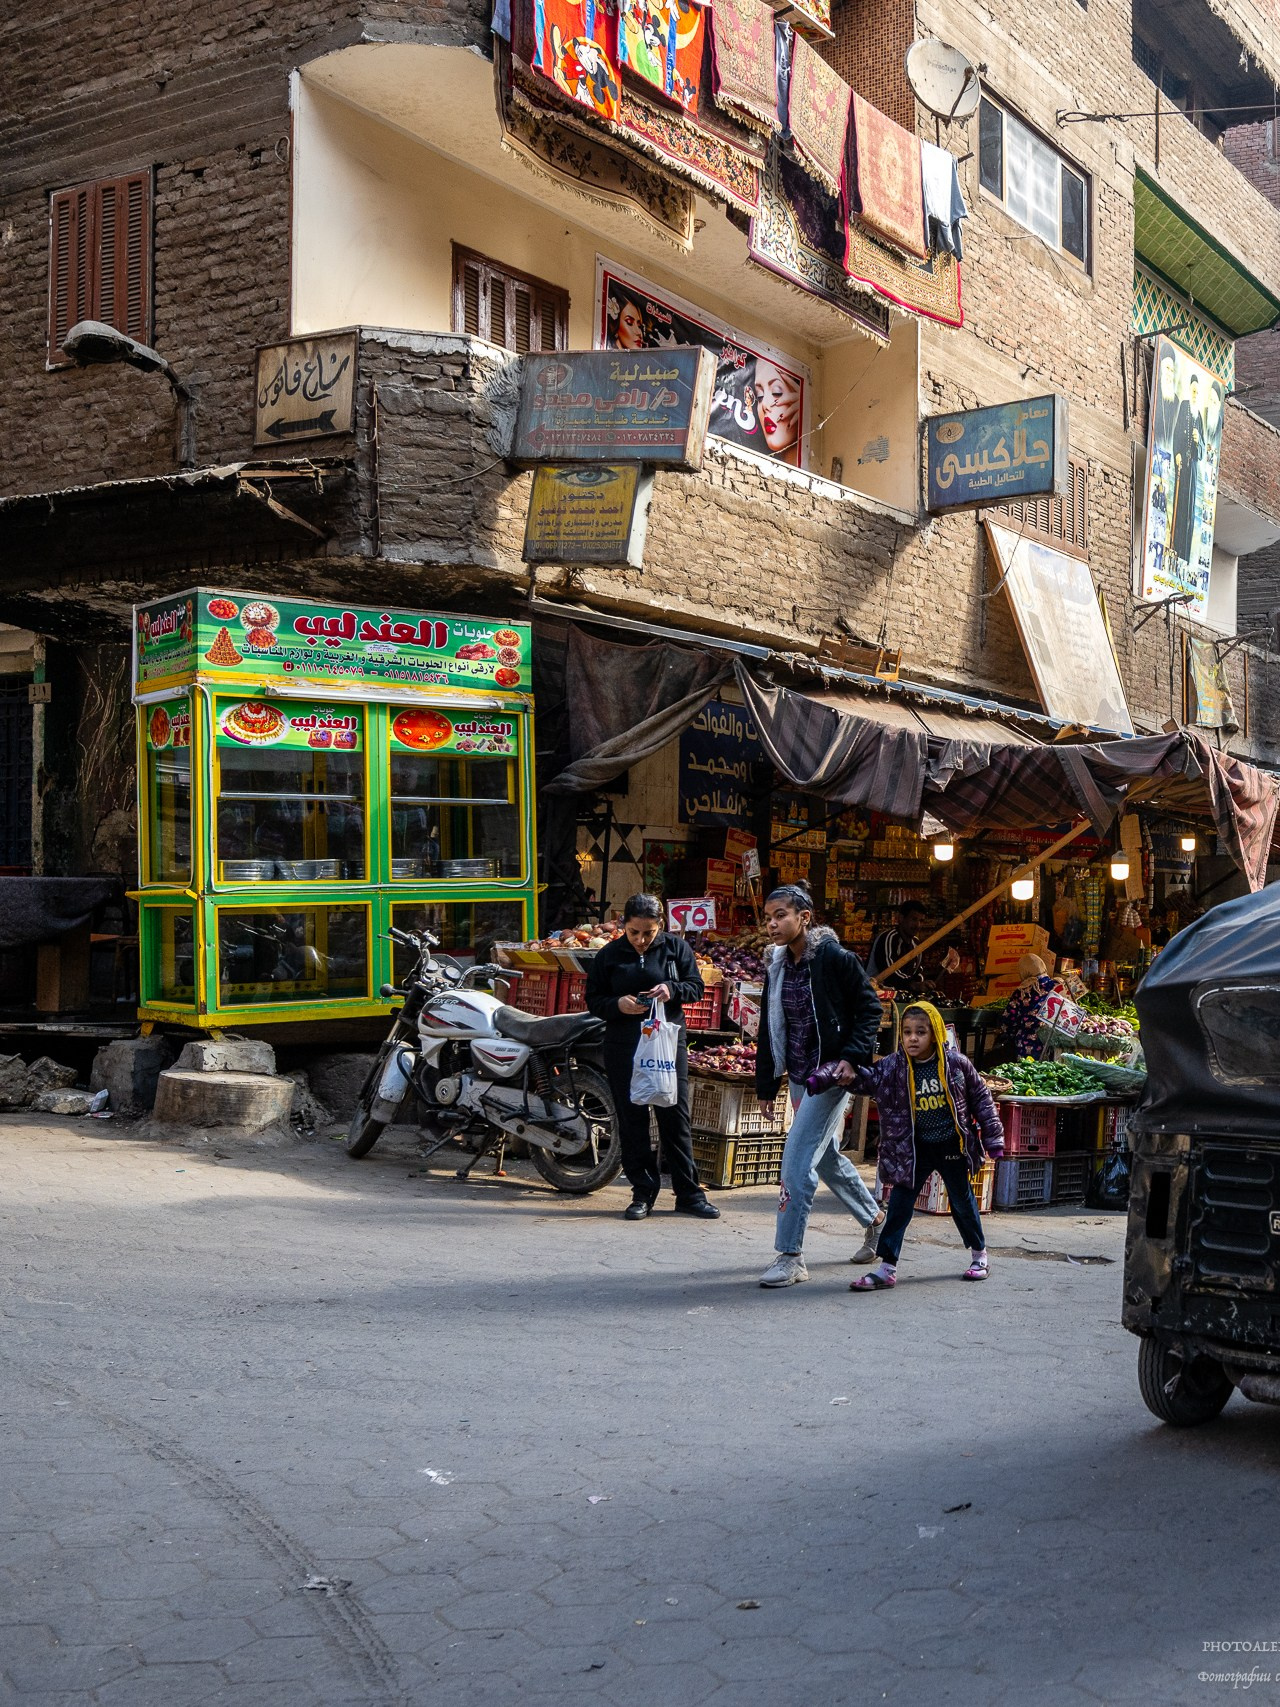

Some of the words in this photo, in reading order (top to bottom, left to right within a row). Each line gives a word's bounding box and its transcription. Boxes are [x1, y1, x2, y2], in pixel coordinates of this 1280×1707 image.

[720, 345, 748, 369] كوافير
[258, 356, 302, 408] فانوس
[302, 351, 350, 402] شارع
[610, 361, 680, 387] صيدلية
[594, 414, 628, 428] طبية
[631, 413, 669, 425] خدمة
[935, 428, 1050, 490] جلاكسى
[968, 475, 993, 490] الطبية
[994, 469, 1025, 487] للتحاليل
[560, 490, 605, 503] دكتور
[569, 504, 596, 514] محمد
[293, 611, 450, 649] العندليب
[453, 622, 495, 643] حلويات
[241, 643, 288, 658] المناسبات
[289, 647, 314, 660] لوازم
[323, 648, 359, 664] الغربية
[368, 652, 406, 668] الشرقية
[408, 657, 448, 671] الحلويات
[448, 662, 470, 673] أنواع
[290, 714, 358, 732] العندليب
[454, 720, 513, 738] العندليب
[685, 788, 742, 824] الفلاحي
[640, 1059, 655, 1068] LC
